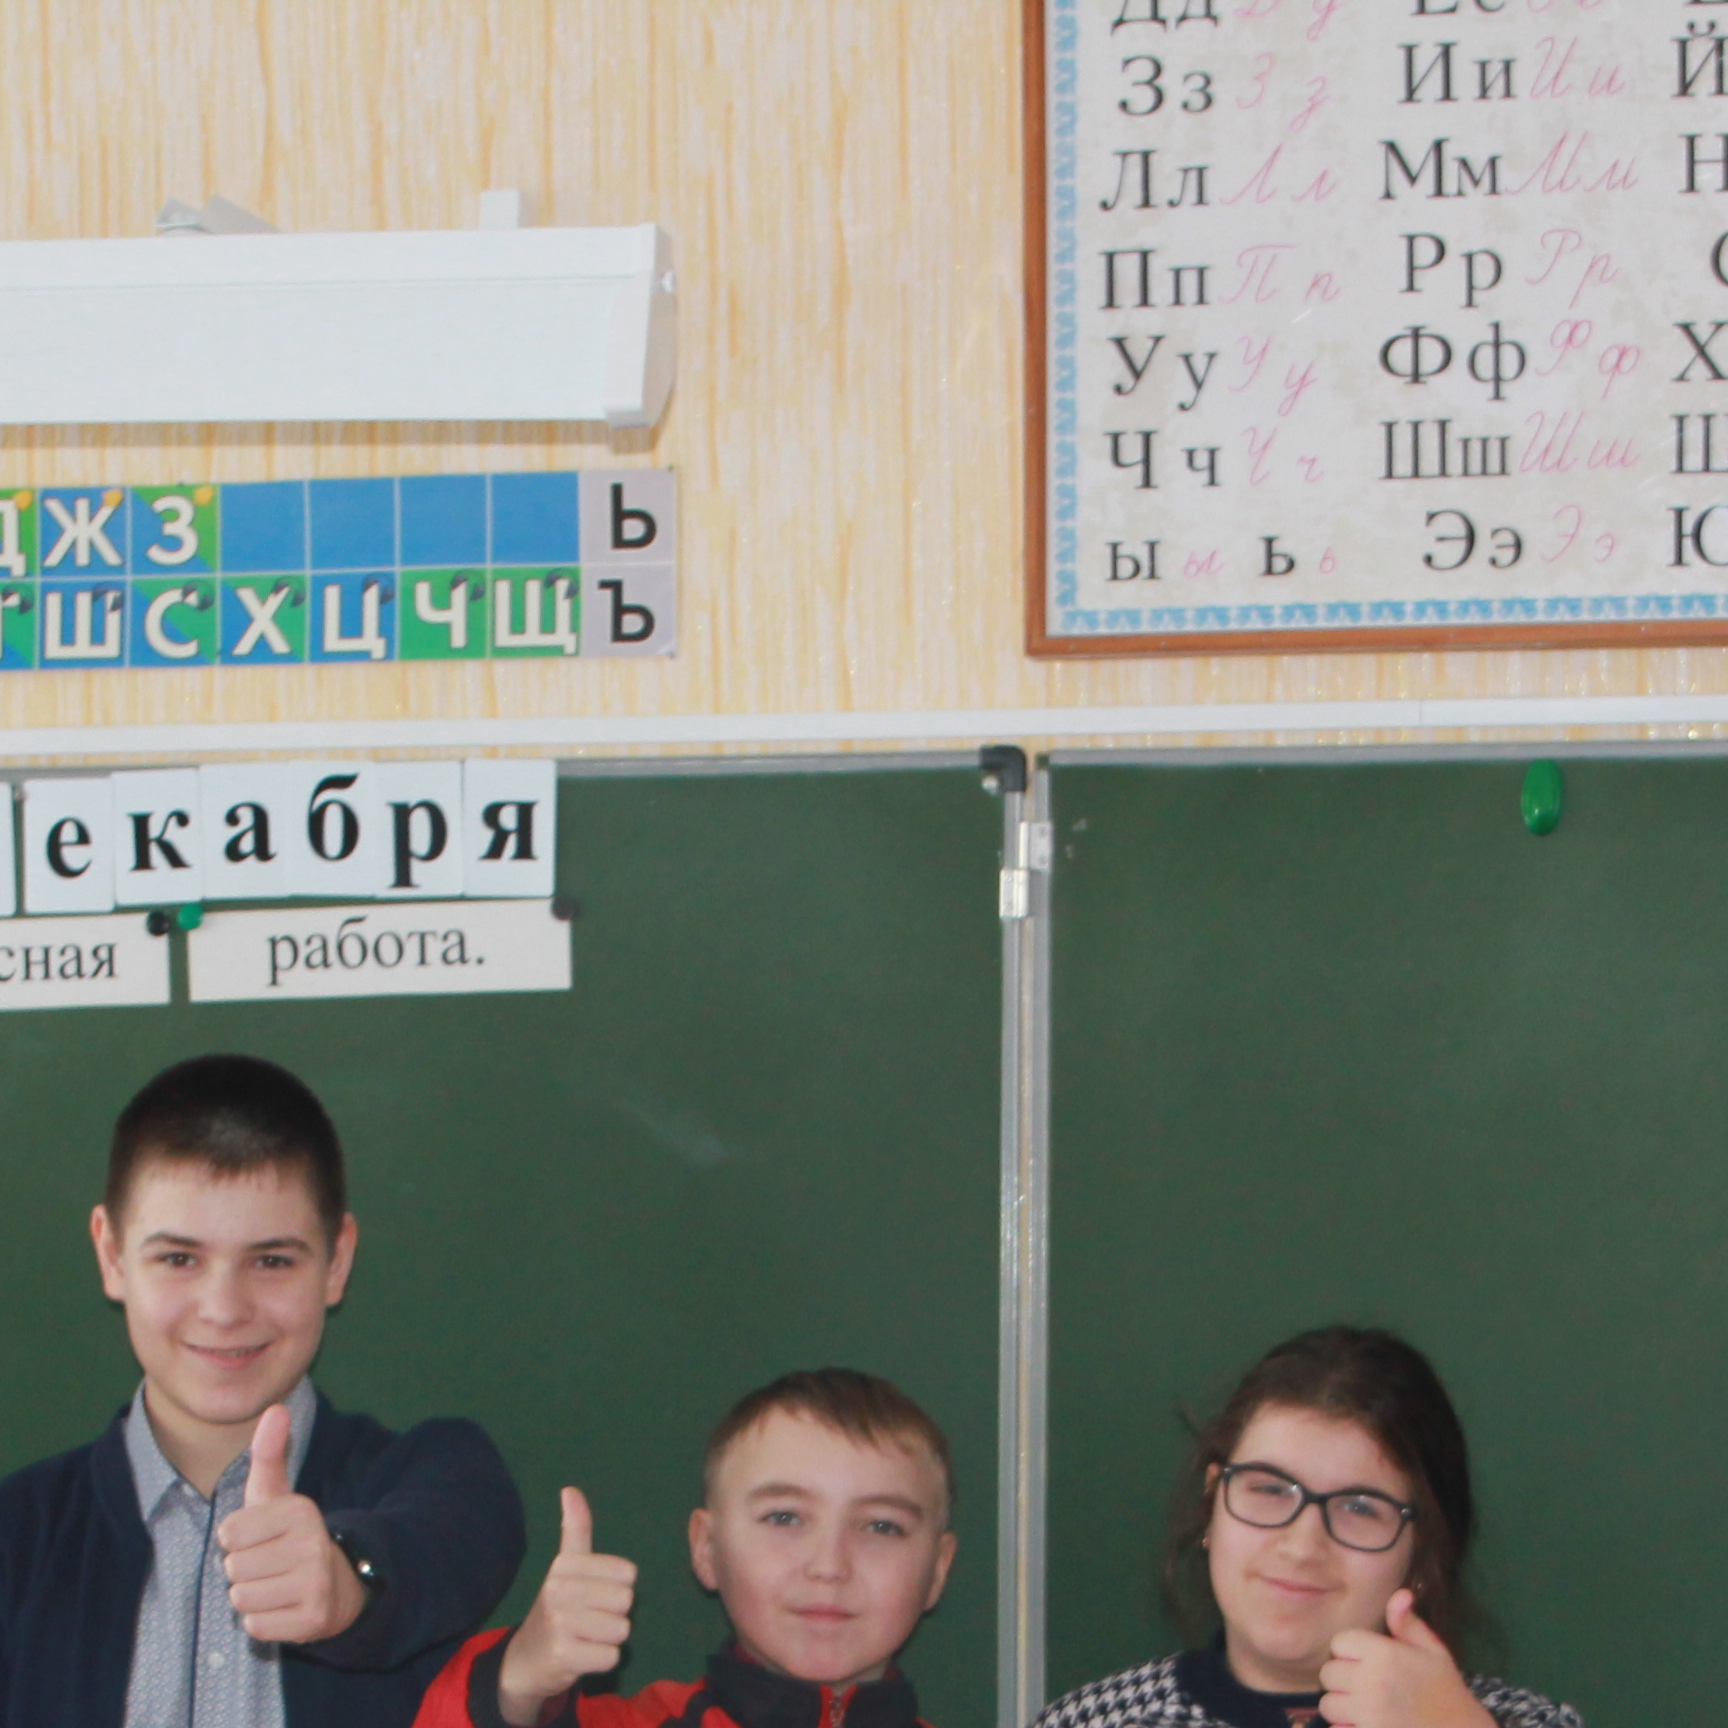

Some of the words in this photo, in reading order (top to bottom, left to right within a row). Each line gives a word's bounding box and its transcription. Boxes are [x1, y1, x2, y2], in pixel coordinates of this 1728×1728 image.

[1118, 55, 1214, 116] Зз
[1398, 41, 1516, 103] Ии
[1099, 149, 1212, 212] Лл
[1378, 137, 1503, 199] Мм
[1099, 248, 1212, 309] Пп
[1399, 233, 1502, 308] Рр
[1109, 335, 1218, 412] Уу
[1379, 321, 1527, 401] Фф
[1104, 430, 1220, 490] Чч
[1379, 418, 1510, 479] Шш
[1106, 540, 1161, 581] ы
[1260, 536, 1295, 577] ь
[1424, 509, 1523, 572] Ээ
[266, 918, 485, 987] работа.
